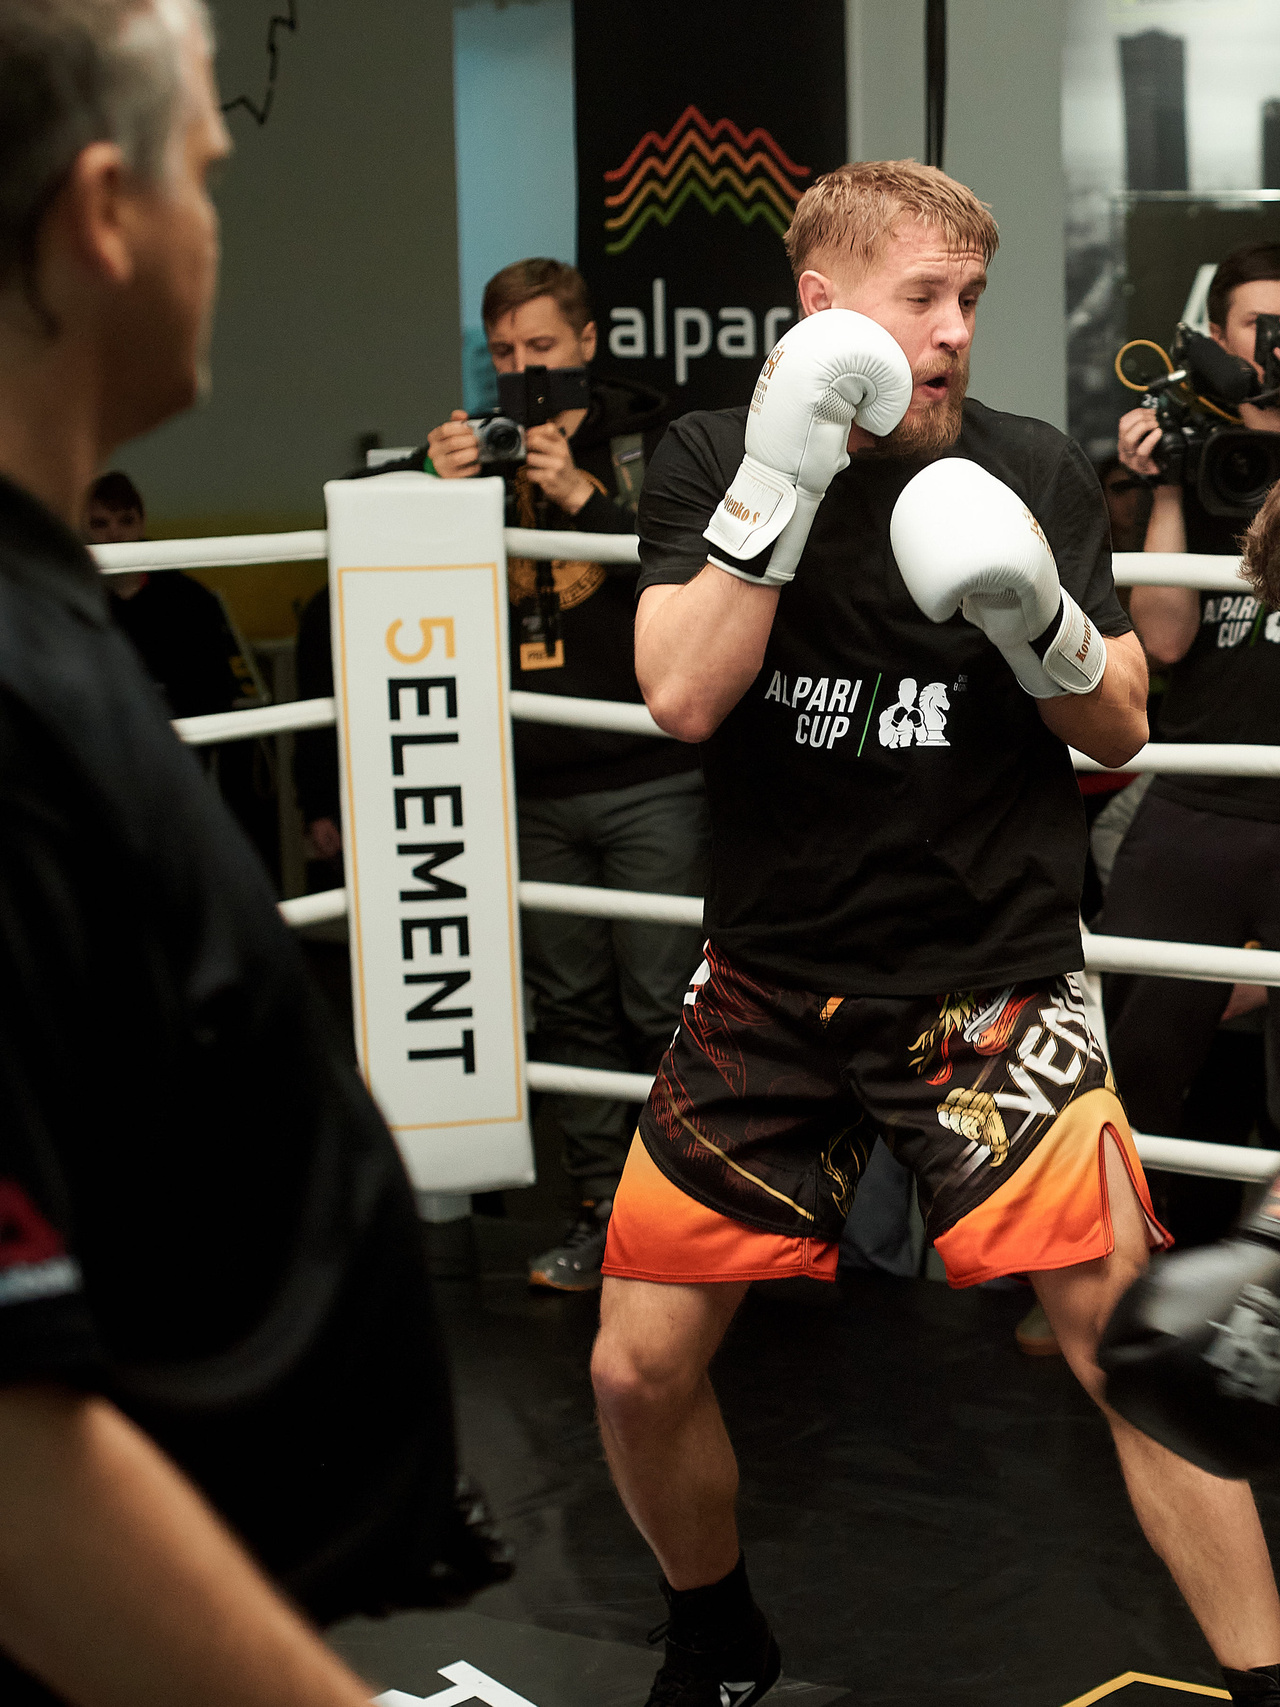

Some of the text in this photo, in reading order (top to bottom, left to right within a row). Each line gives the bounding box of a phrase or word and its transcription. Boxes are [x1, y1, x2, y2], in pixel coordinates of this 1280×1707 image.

[609, 277, 793, 386] alpar
[764, 670, 862, 713] ALPARI
[795, 713, 850, 749] CUP
